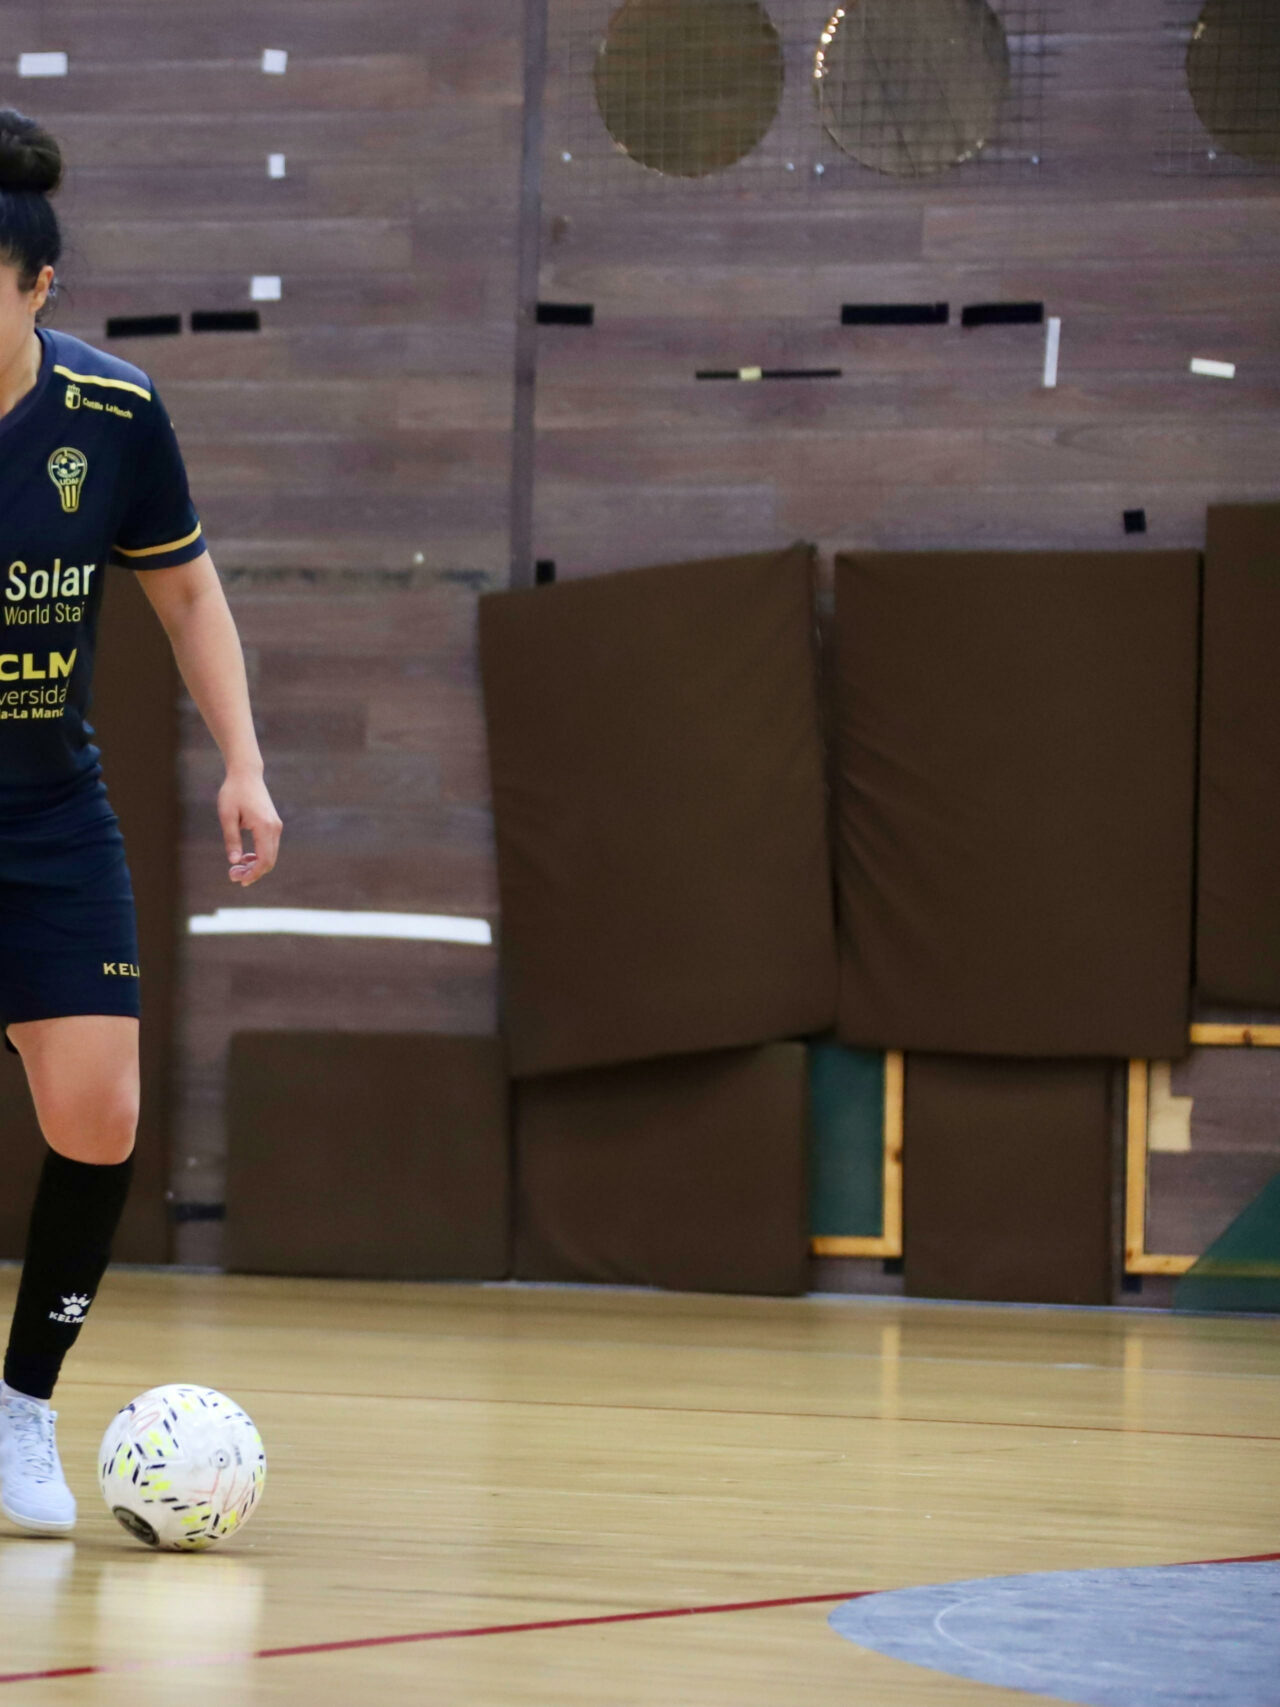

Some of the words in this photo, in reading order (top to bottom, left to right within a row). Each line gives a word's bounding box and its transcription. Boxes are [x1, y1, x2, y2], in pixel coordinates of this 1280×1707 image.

[5, 558, 96, 602] Solar
[4, 603, 50, 626] World
[103, 962, 140, 978] KEL
